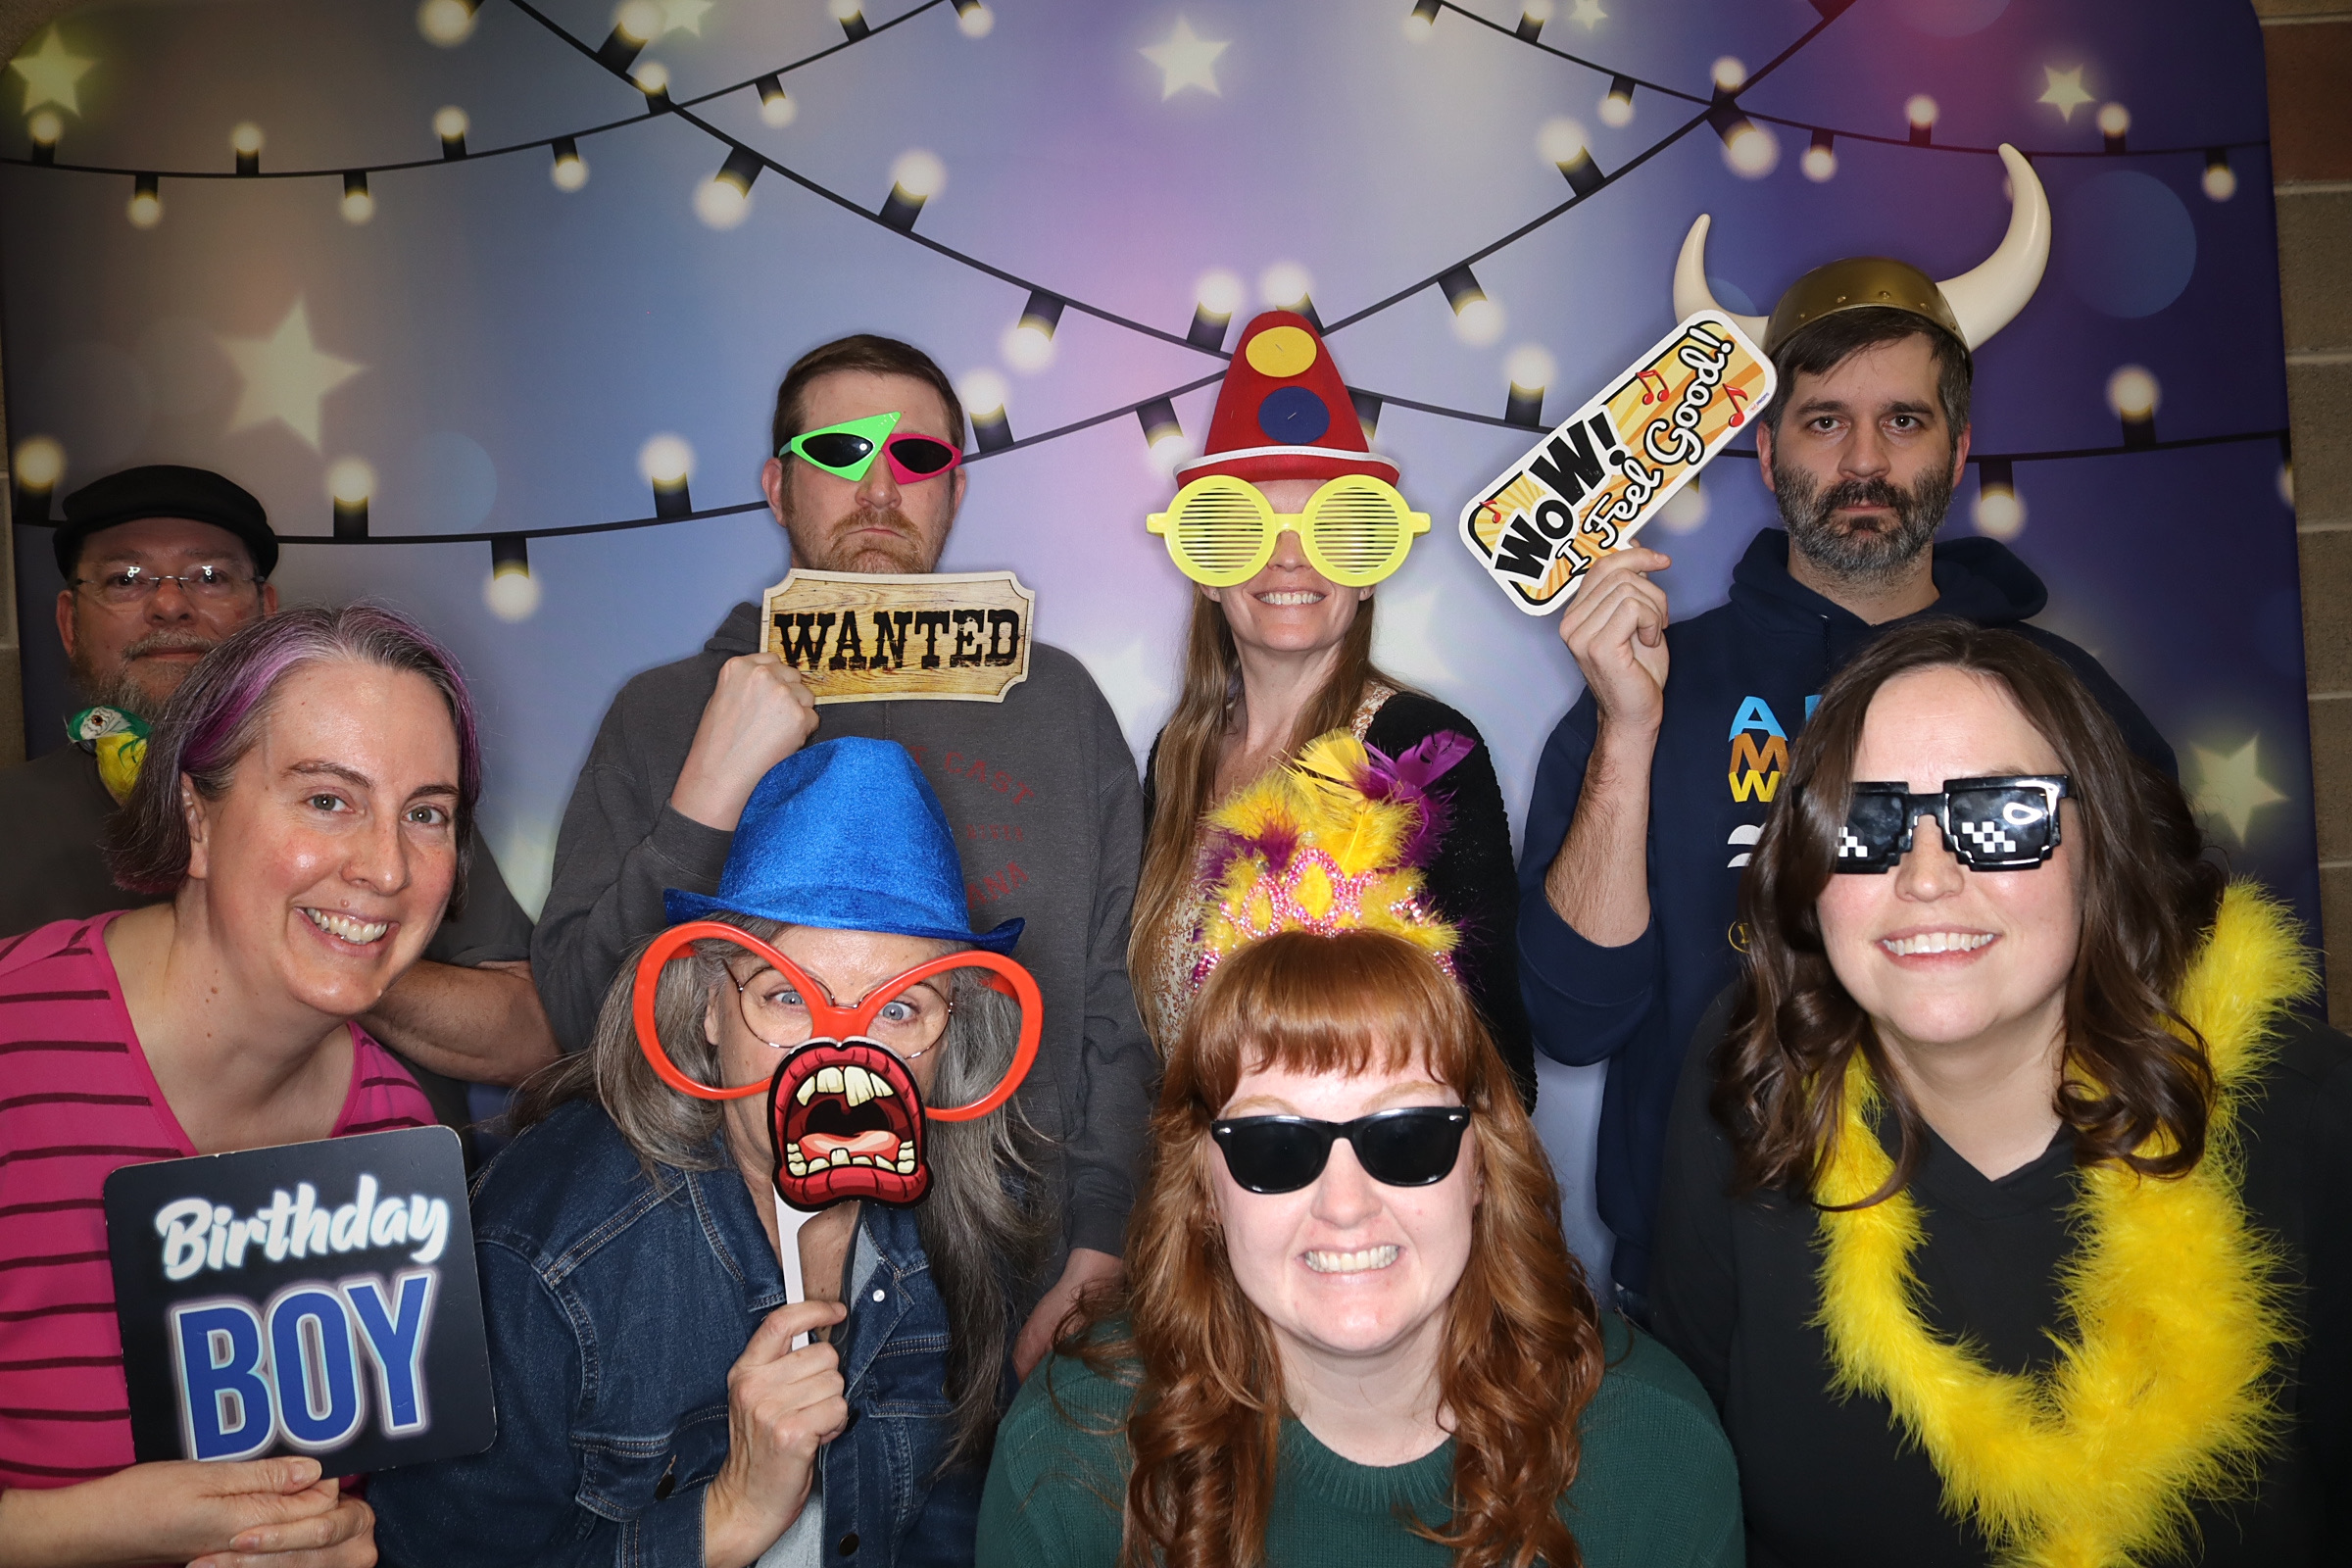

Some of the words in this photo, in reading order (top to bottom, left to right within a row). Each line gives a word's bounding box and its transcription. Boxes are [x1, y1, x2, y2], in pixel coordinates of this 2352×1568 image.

[1555, 539, 1592, 575] I
[1582, 456, 1664, 549] Feel
[1643, 325, 1735, 466] Good!
[773, 609, 1020, 670] WANTED
[944, 751, 1035, 806] CAST
[155, 1173, 451, 1280] Birthday
[173, 1273, 436, 1462] BOY
